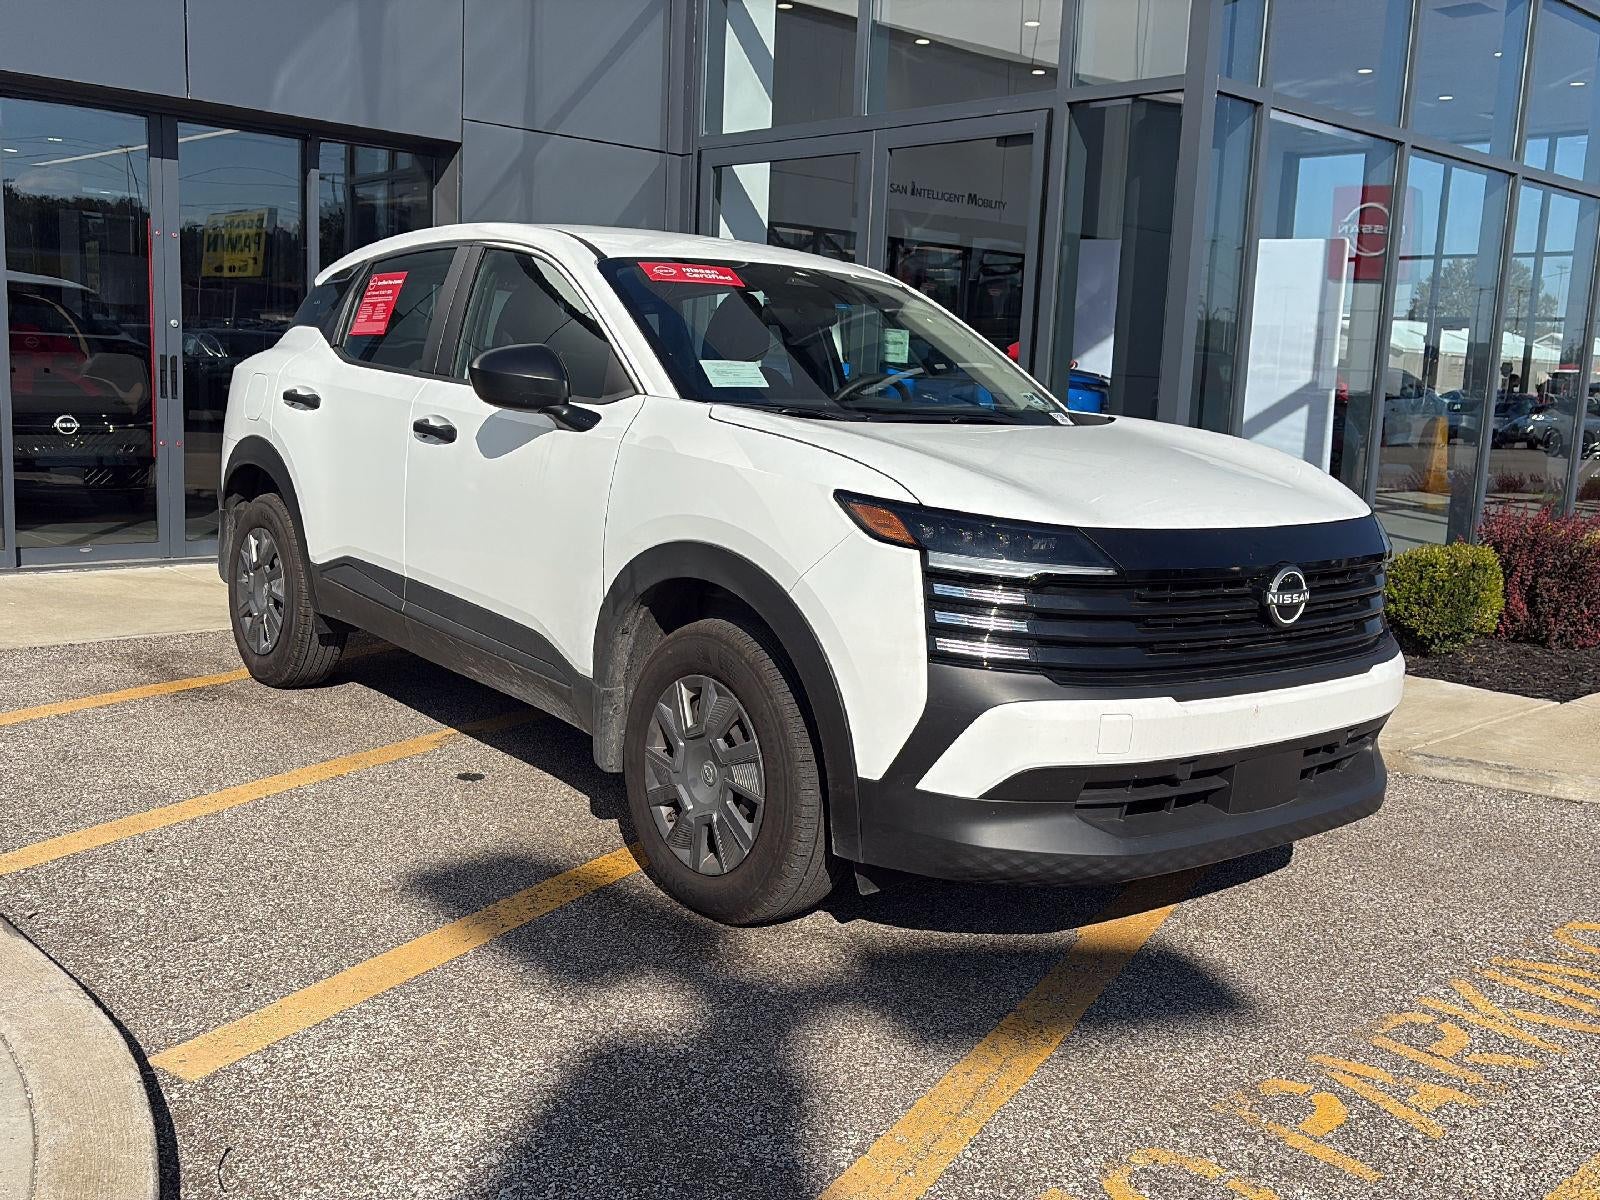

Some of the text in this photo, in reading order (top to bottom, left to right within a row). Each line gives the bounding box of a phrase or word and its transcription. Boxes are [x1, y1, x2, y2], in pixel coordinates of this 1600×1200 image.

[910, 180, 966, 204] INTELLIGENT
[967, 192, 1008, 211] MOBILITY
[1268, 590, 1310, 604] NISSAN
